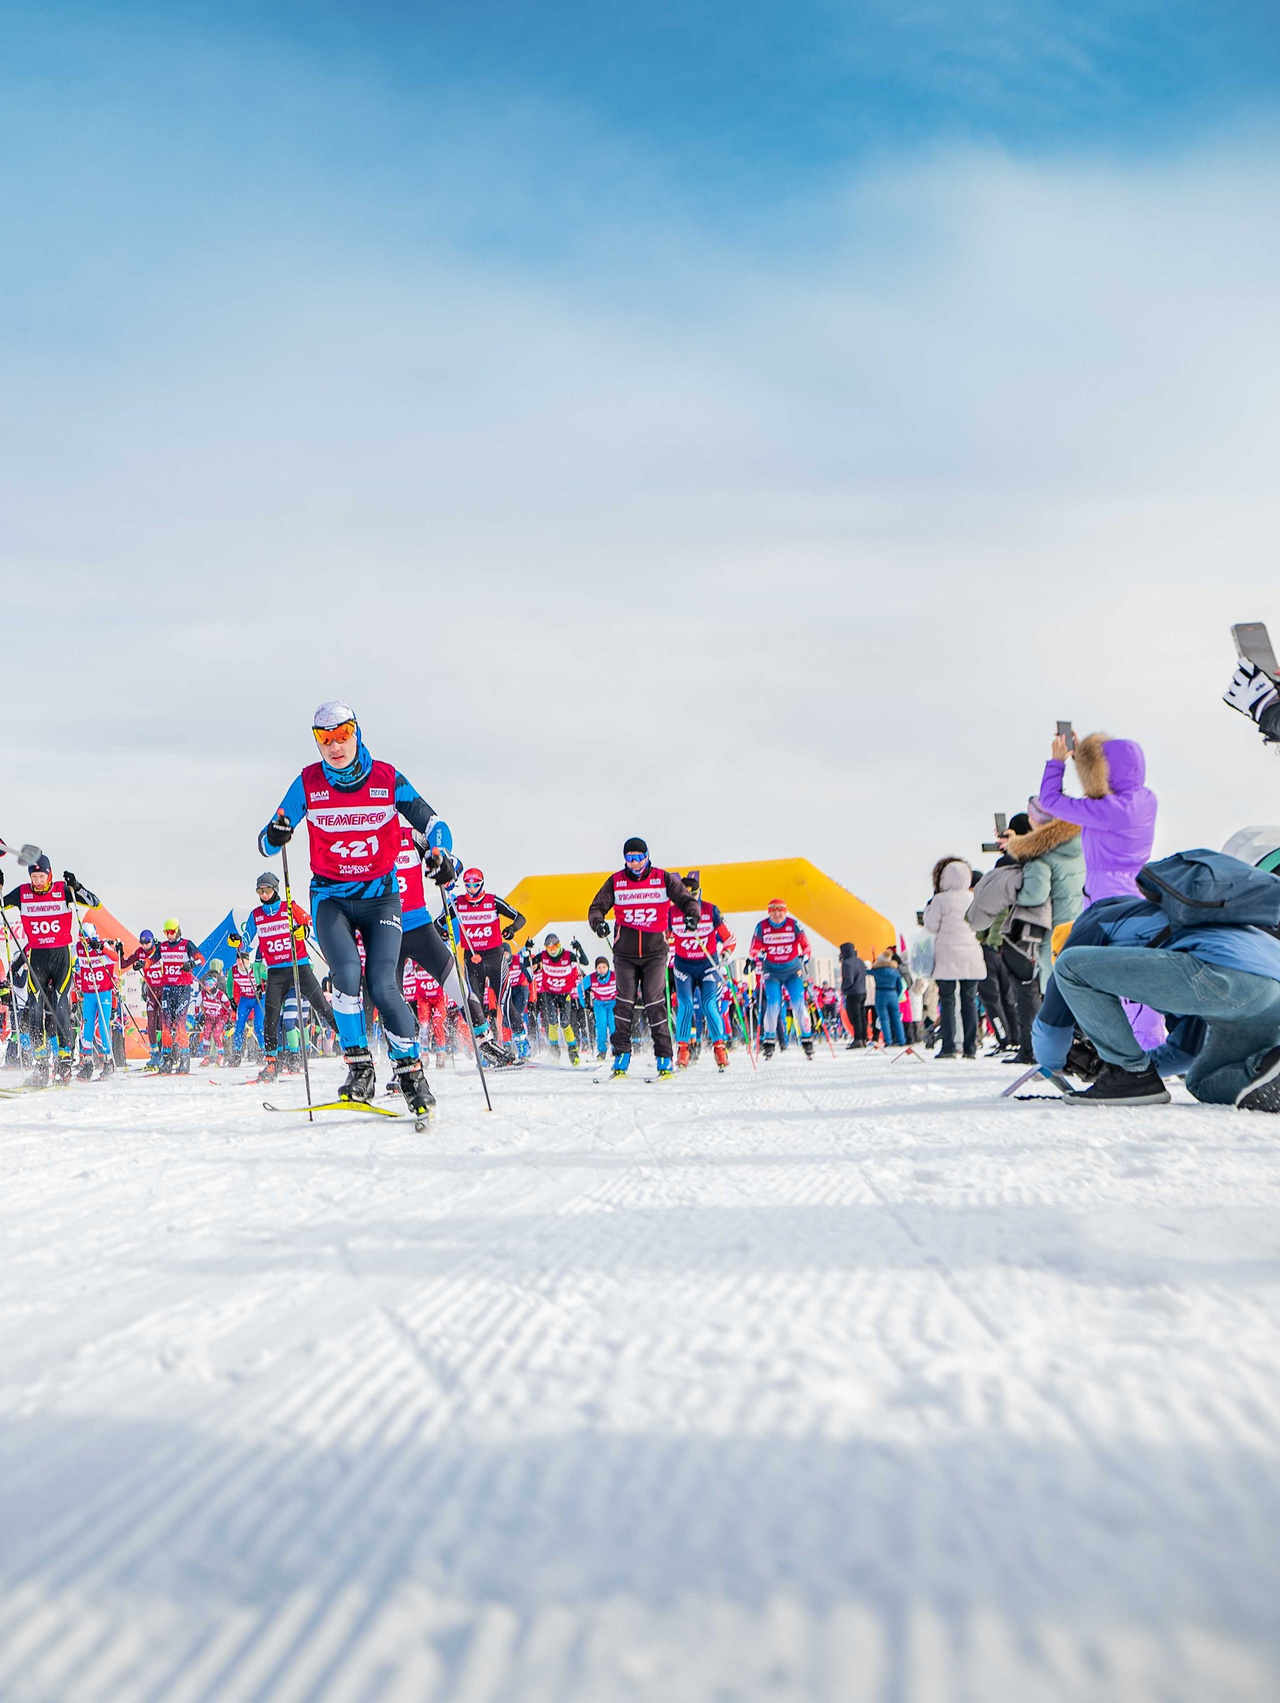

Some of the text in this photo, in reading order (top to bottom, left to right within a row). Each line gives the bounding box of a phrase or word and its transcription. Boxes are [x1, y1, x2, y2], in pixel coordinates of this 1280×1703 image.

[315, 811, 387, 826] ТЕМЕРСО
[328, 834, 380, 858] 421
[623, 908, 657, 923] 352
[30, 919, 61, 934] 306
[466, 926, 493, 939] 448
[266, 938, 292, 953] 265
